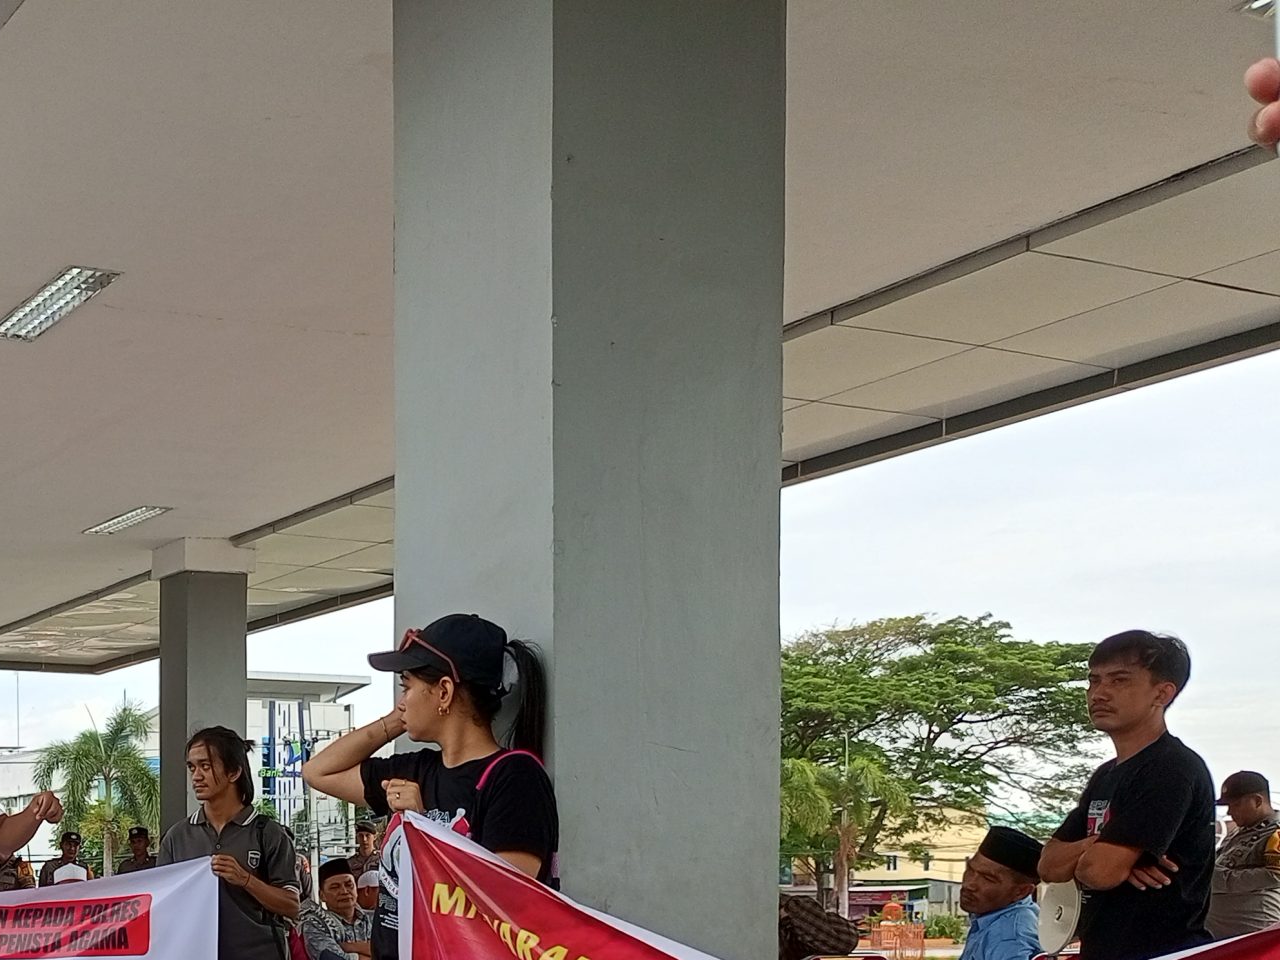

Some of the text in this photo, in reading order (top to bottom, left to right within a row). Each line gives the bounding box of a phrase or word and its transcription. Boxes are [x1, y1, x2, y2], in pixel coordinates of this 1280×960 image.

[12, 906, 75, 929] KEPADA
[80, 899, 140, 925] POLRES
[66, 926, 129, 952] AGAMA
